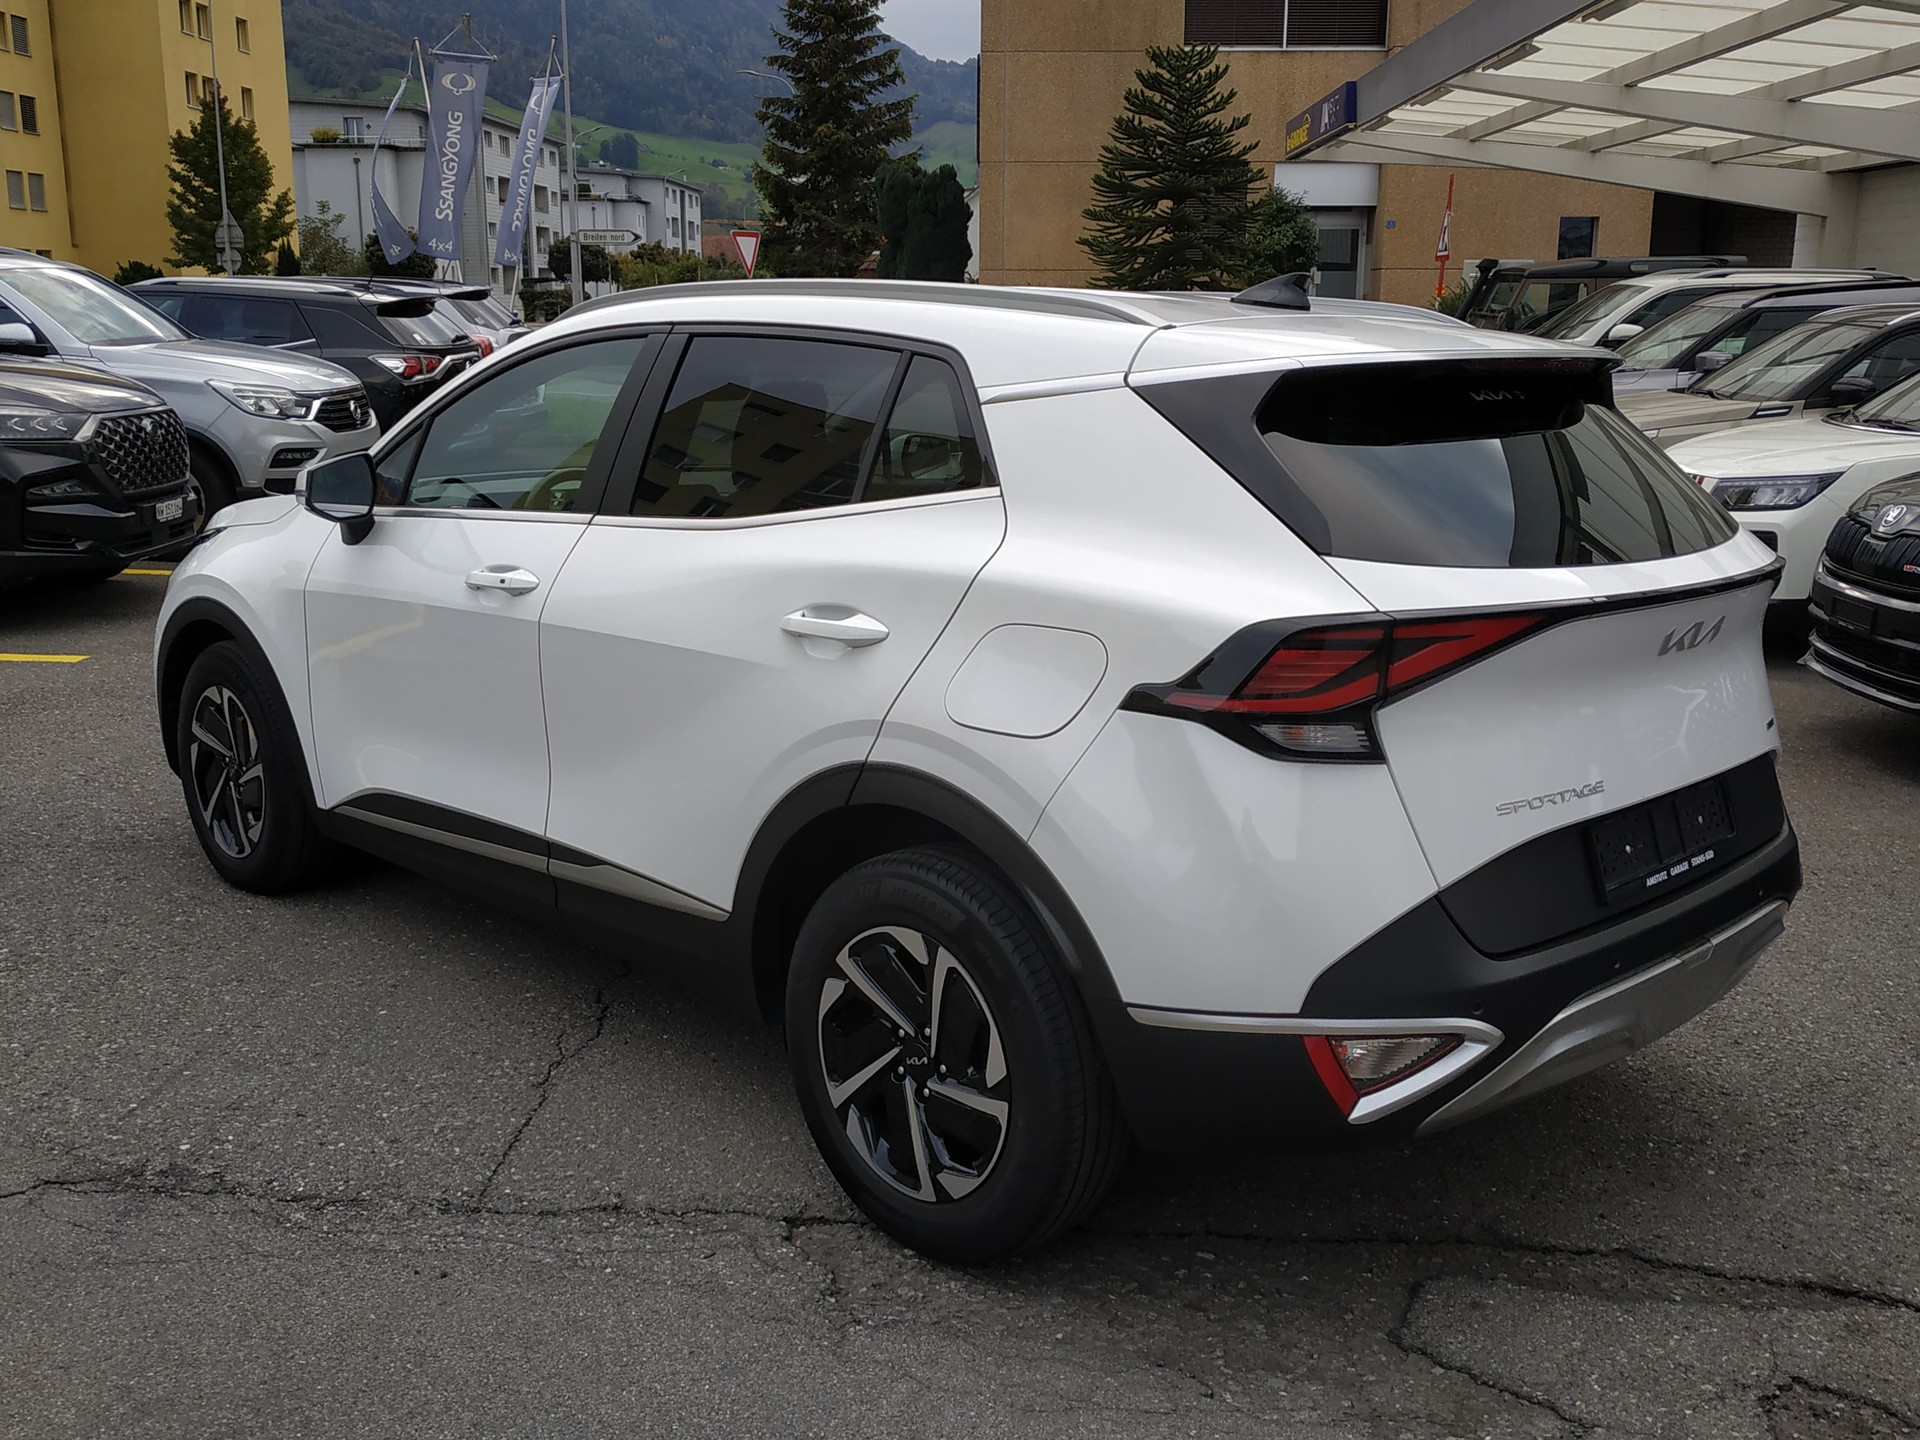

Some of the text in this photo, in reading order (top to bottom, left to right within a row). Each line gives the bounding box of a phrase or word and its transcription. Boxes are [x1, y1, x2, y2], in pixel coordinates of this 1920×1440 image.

[434, 110, 463, 222] SSANGYONG
[428, 238, 454, 253] 4x4
[583, 232, 625, 241] Breiten nord
[1657, 614, 1727, 657] KIA
[1495, 779, 1606, 817] SPORTAGE
[1646, 870, 1669, 888] AMSTUTZ
[1669, 861, 1690, 877] GARAGE
[905, 1056, 929, 1066] KIA
